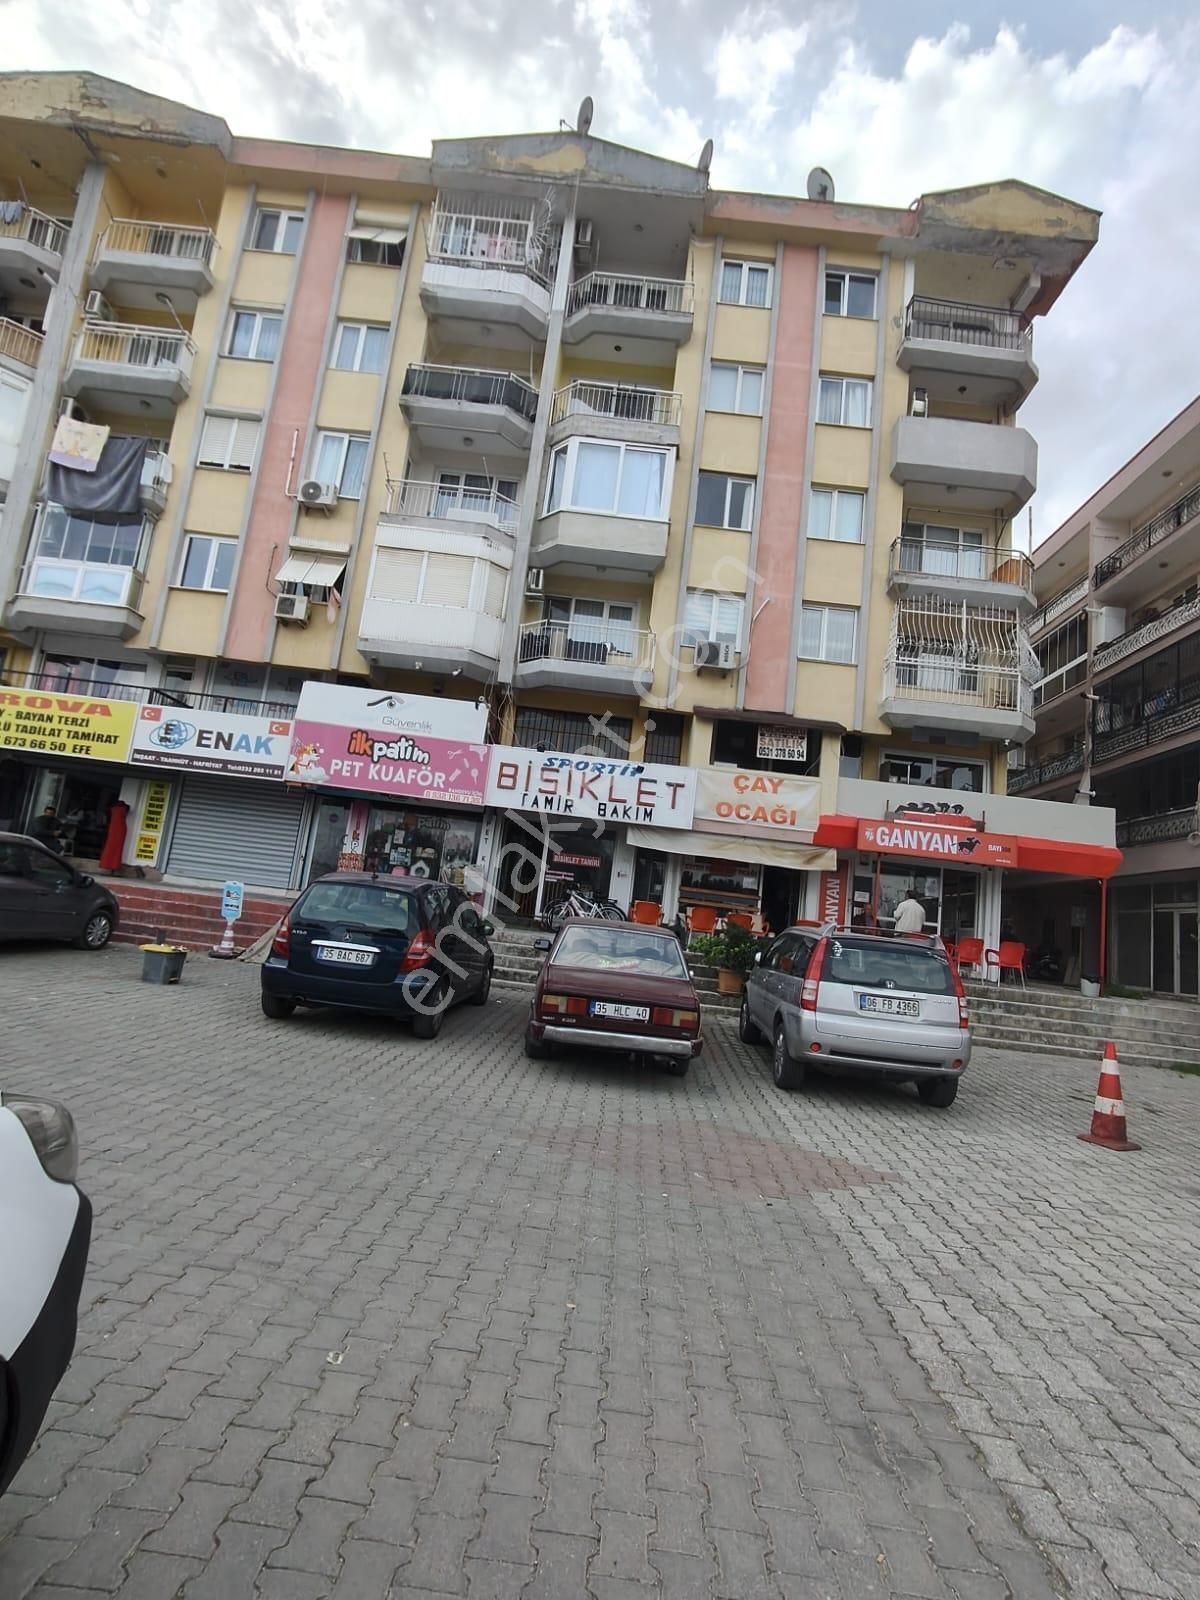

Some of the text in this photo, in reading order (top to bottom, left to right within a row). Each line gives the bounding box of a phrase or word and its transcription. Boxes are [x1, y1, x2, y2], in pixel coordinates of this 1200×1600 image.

[16, 710, 54, 723] BAYAN
[58, 716, 90, 728] TERZİ
[4, 735, 92, 755] 673 66 50 EFE
[66, 729, 120, 745] TAMİRAT
[196, 729, 275, 755] ENAK
[759, 737, 804, 749] SATILIK
[759, 746, 773, 756] 0531
[330, 759, 446, 788] PET KUAFÖR
[733, 774, 784, 794] ÇAY
[521, 793, 653, 822] TAMİR BAKIM
[715, 801, 797, 826] OCAĞI
[876, 826, 958, 855] GANYAN
[824, 878, 840, 924] ANYAN
[324, 948, 334, 959] 35
[355, 953, 371, 963] 687
[596, 1003, 648, 1019] 35 HLC 40
[867, 997, 918, 1012] 06 FB 4366
